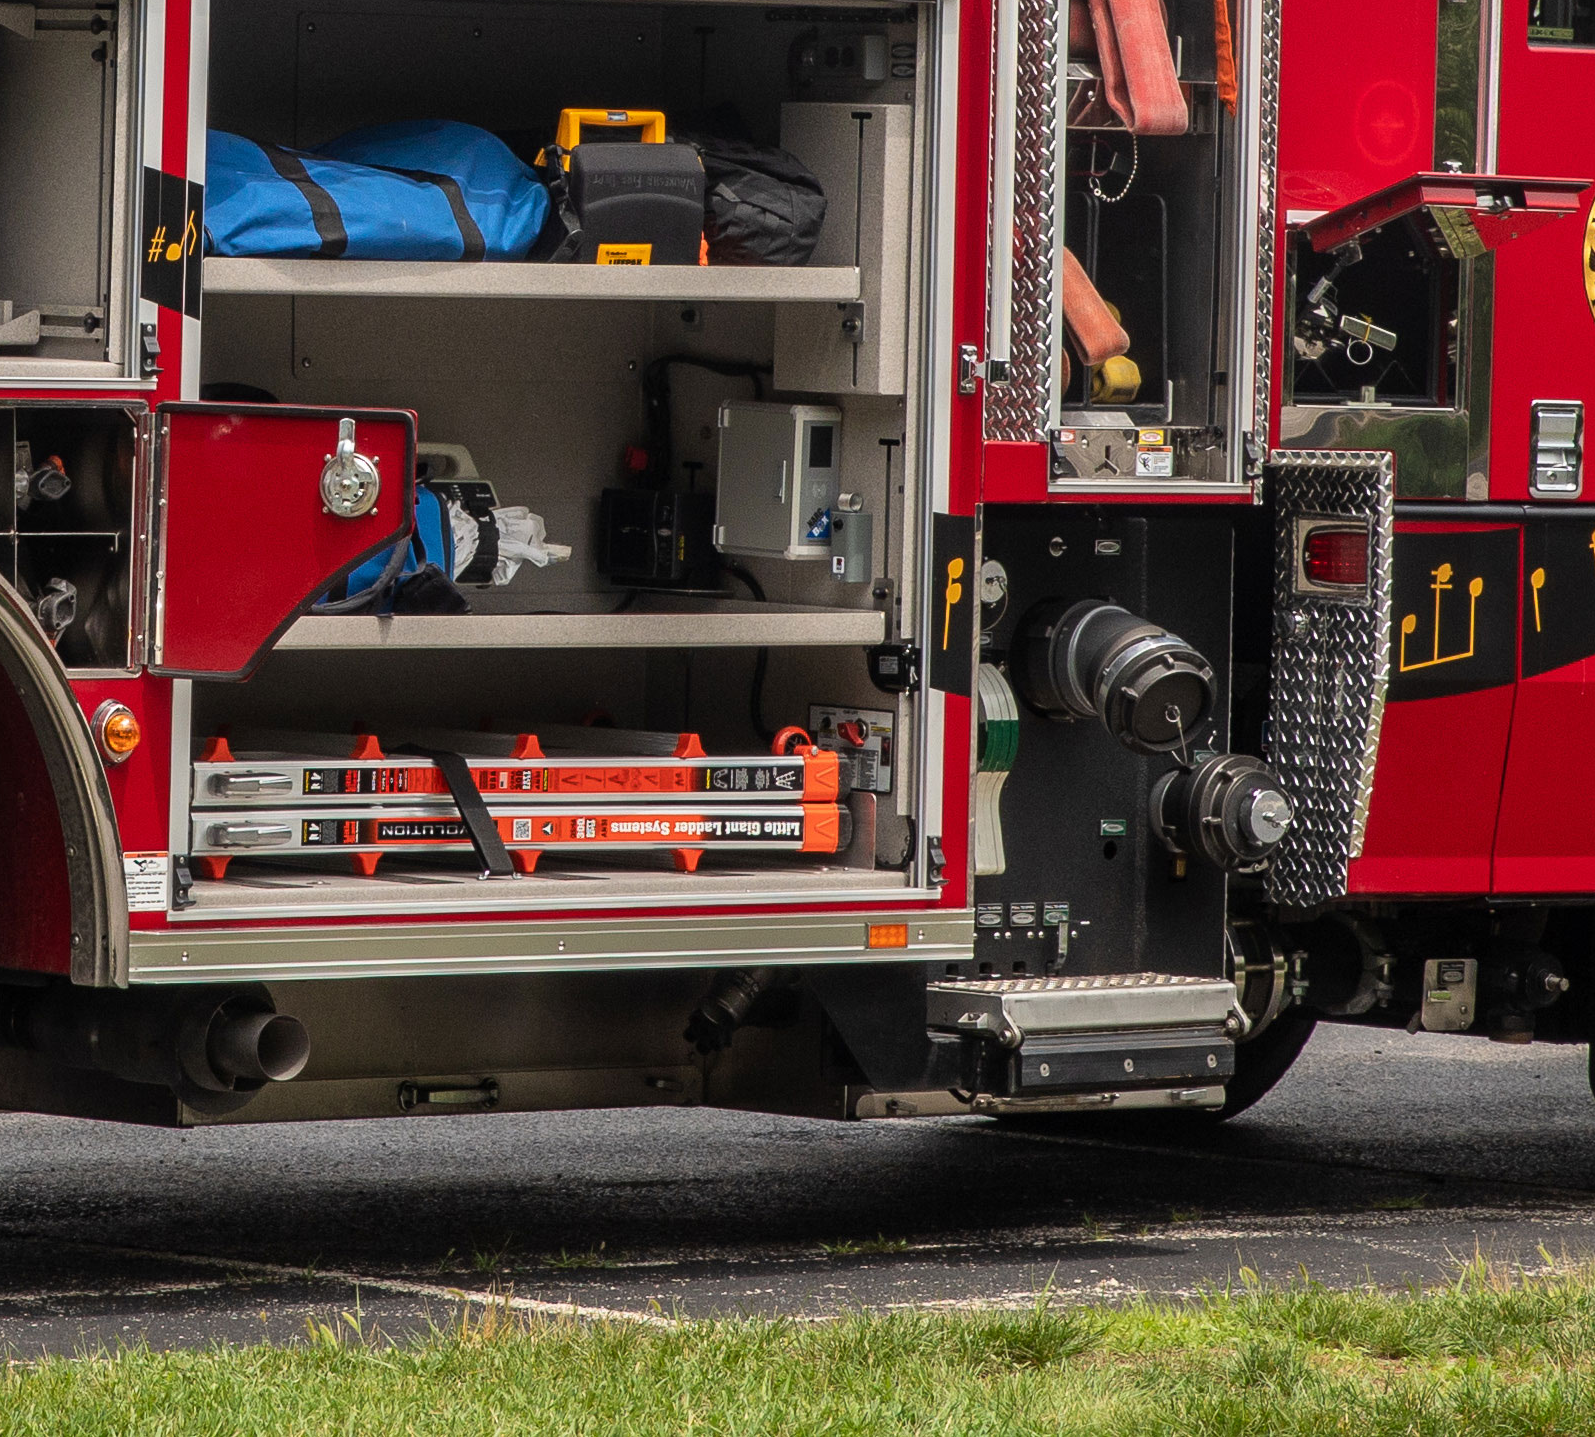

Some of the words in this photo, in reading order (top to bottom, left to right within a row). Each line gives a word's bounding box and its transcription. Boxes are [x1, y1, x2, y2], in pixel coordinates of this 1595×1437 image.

[812, 515, 829, 537] BOX
[611, 819, 670, 836] Systems
[674, 820, 722, 836] Ladder
[724, 820, 761, 836] Giant
[764, 820, 800, 836] Little
